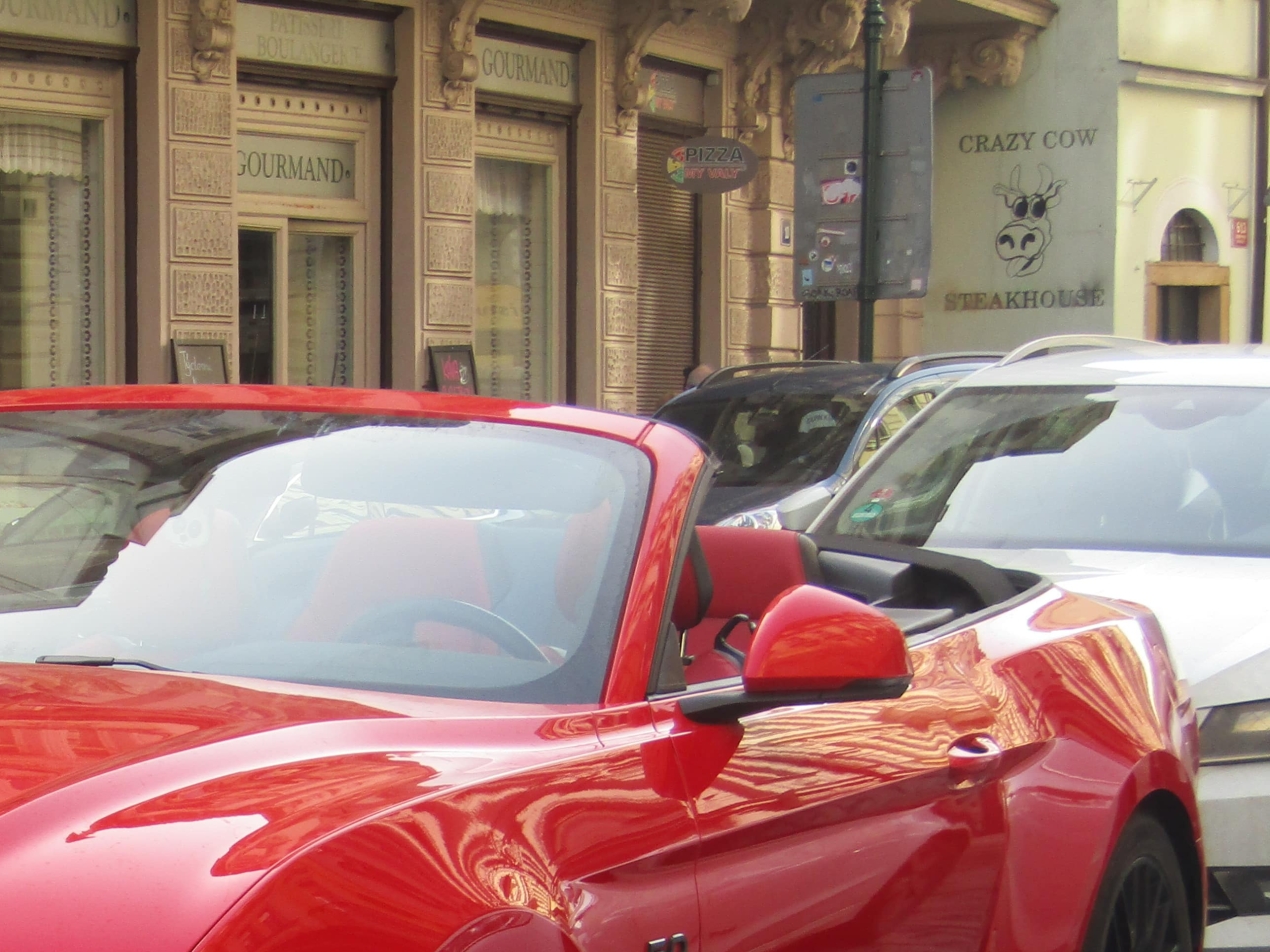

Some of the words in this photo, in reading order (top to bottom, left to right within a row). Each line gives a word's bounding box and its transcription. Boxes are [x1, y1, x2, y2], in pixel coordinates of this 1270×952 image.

[482, 47, 570, 88] GOURMAND
[959, 132, 1036, 153] CRAZY
[1043, 128, 1098, 149] COW
[236, 149, 344, 184] GOURMAND
[684, 146, 744, 163] PIZZA
[943, 288, 1106, 312] STEAKHOUSE
